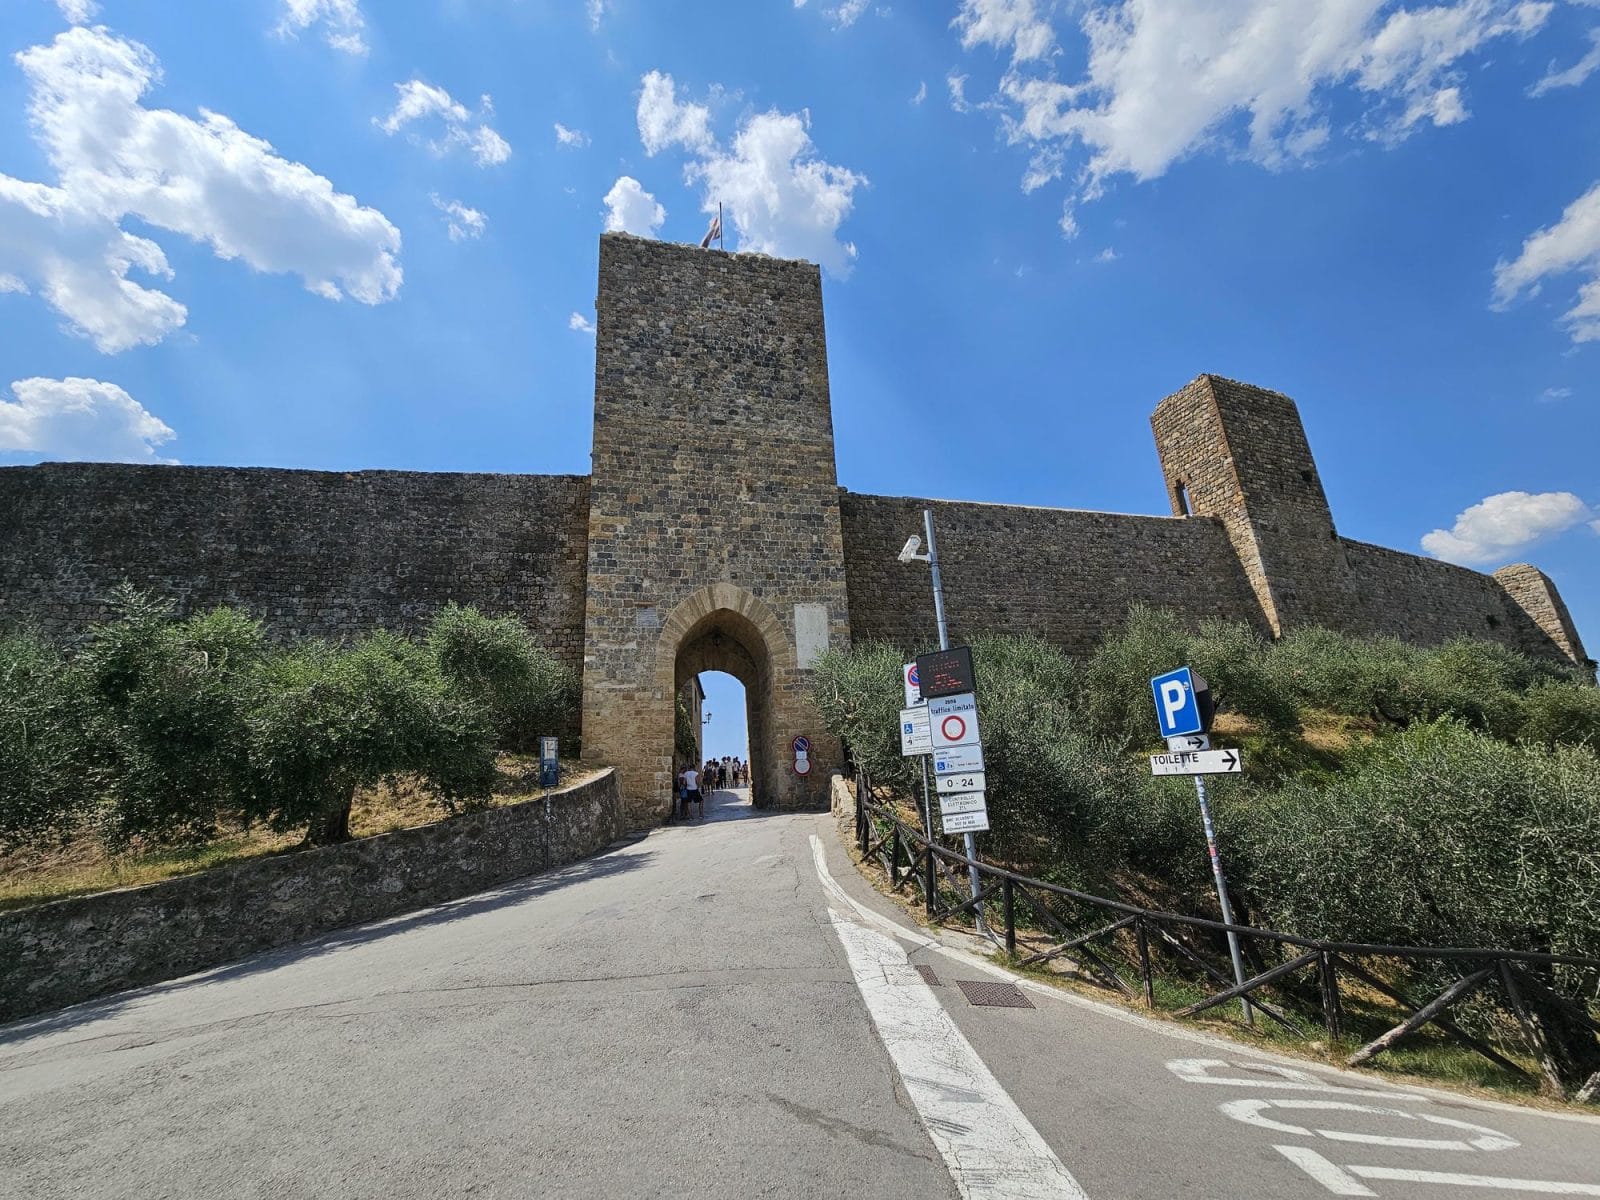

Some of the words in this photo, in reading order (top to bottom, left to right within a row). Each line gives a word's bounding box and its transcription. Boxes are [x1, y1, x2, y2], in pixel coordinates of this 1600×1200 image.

[930, 707, 951, 715] traffico
[952, 704, 975, 712] limitato
[1160, 679, 1186, 729] P
[1153, 753, 1199, 765] TOILETTE
[946, 779, 953, 788] 0
[961, 778, 974, 787] 24
[947, 800, 978, 808] ELETTRONICO
